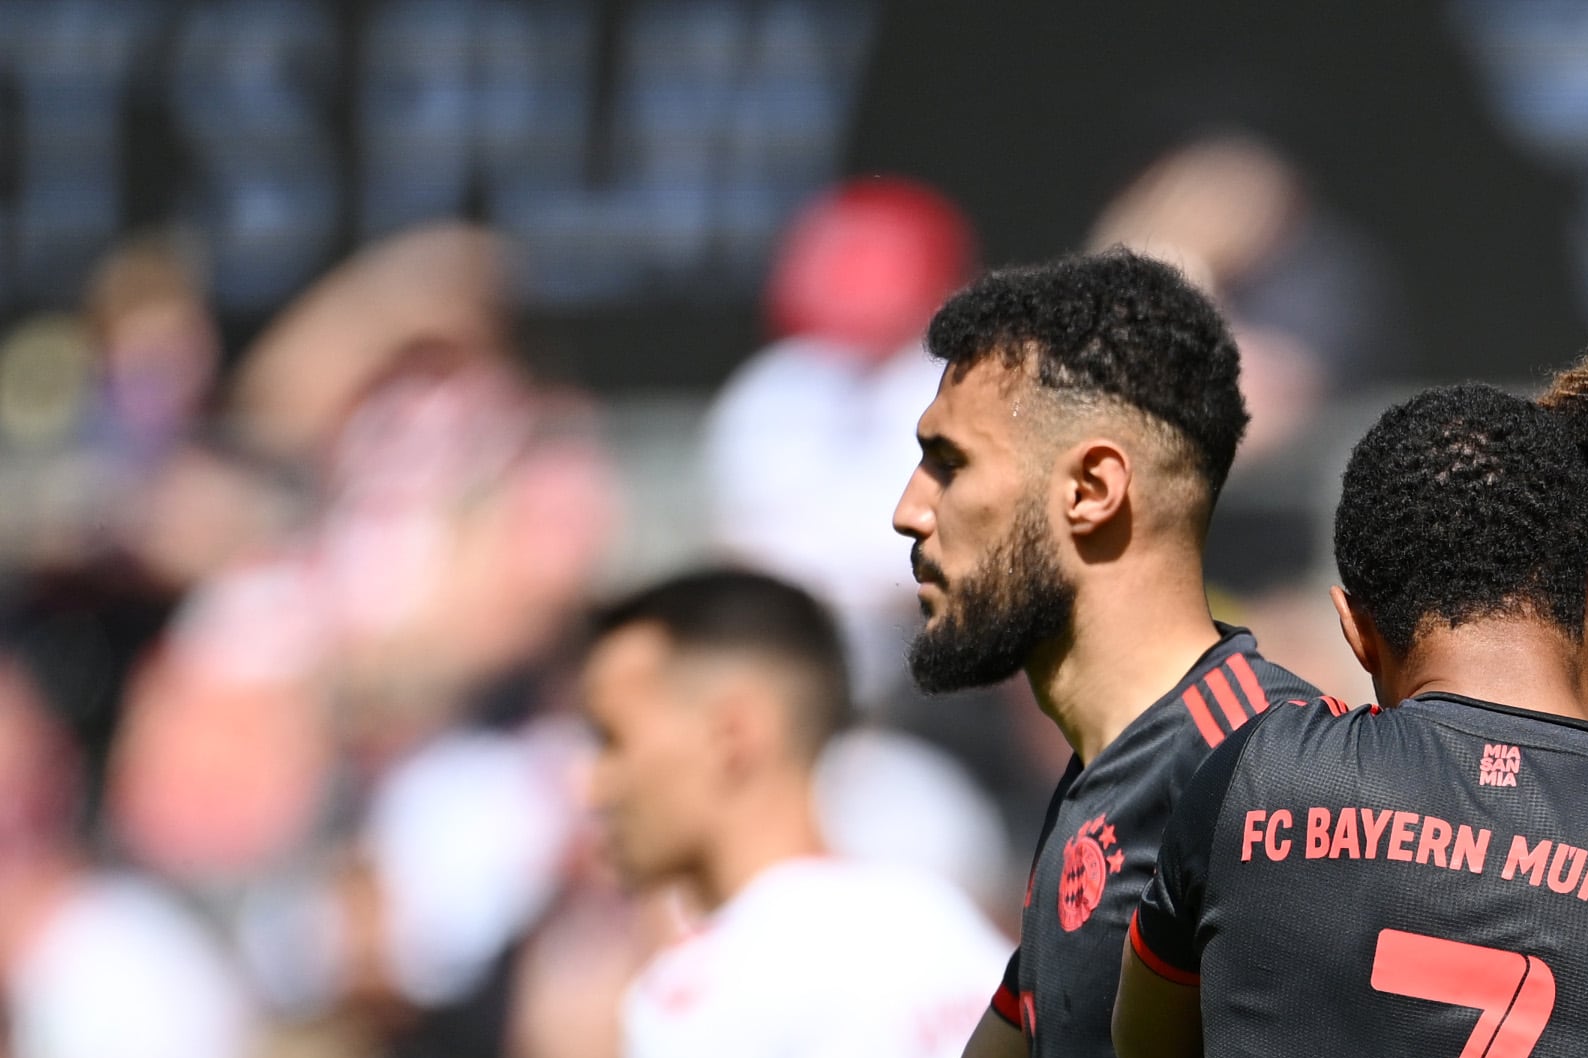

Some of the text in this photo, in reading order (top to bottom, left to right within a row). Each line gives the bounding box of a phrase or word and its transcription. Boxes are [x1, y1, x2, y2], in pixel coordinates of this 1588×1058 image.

[1483, 743, 1521, 760] MIA
[1480, 757, 1520, 774] SAN
[1479, 770, 1517, 787] MIA
[1241, 809, 1293, 864] FC
[1305, 806, 1492, 875] BAYERN
